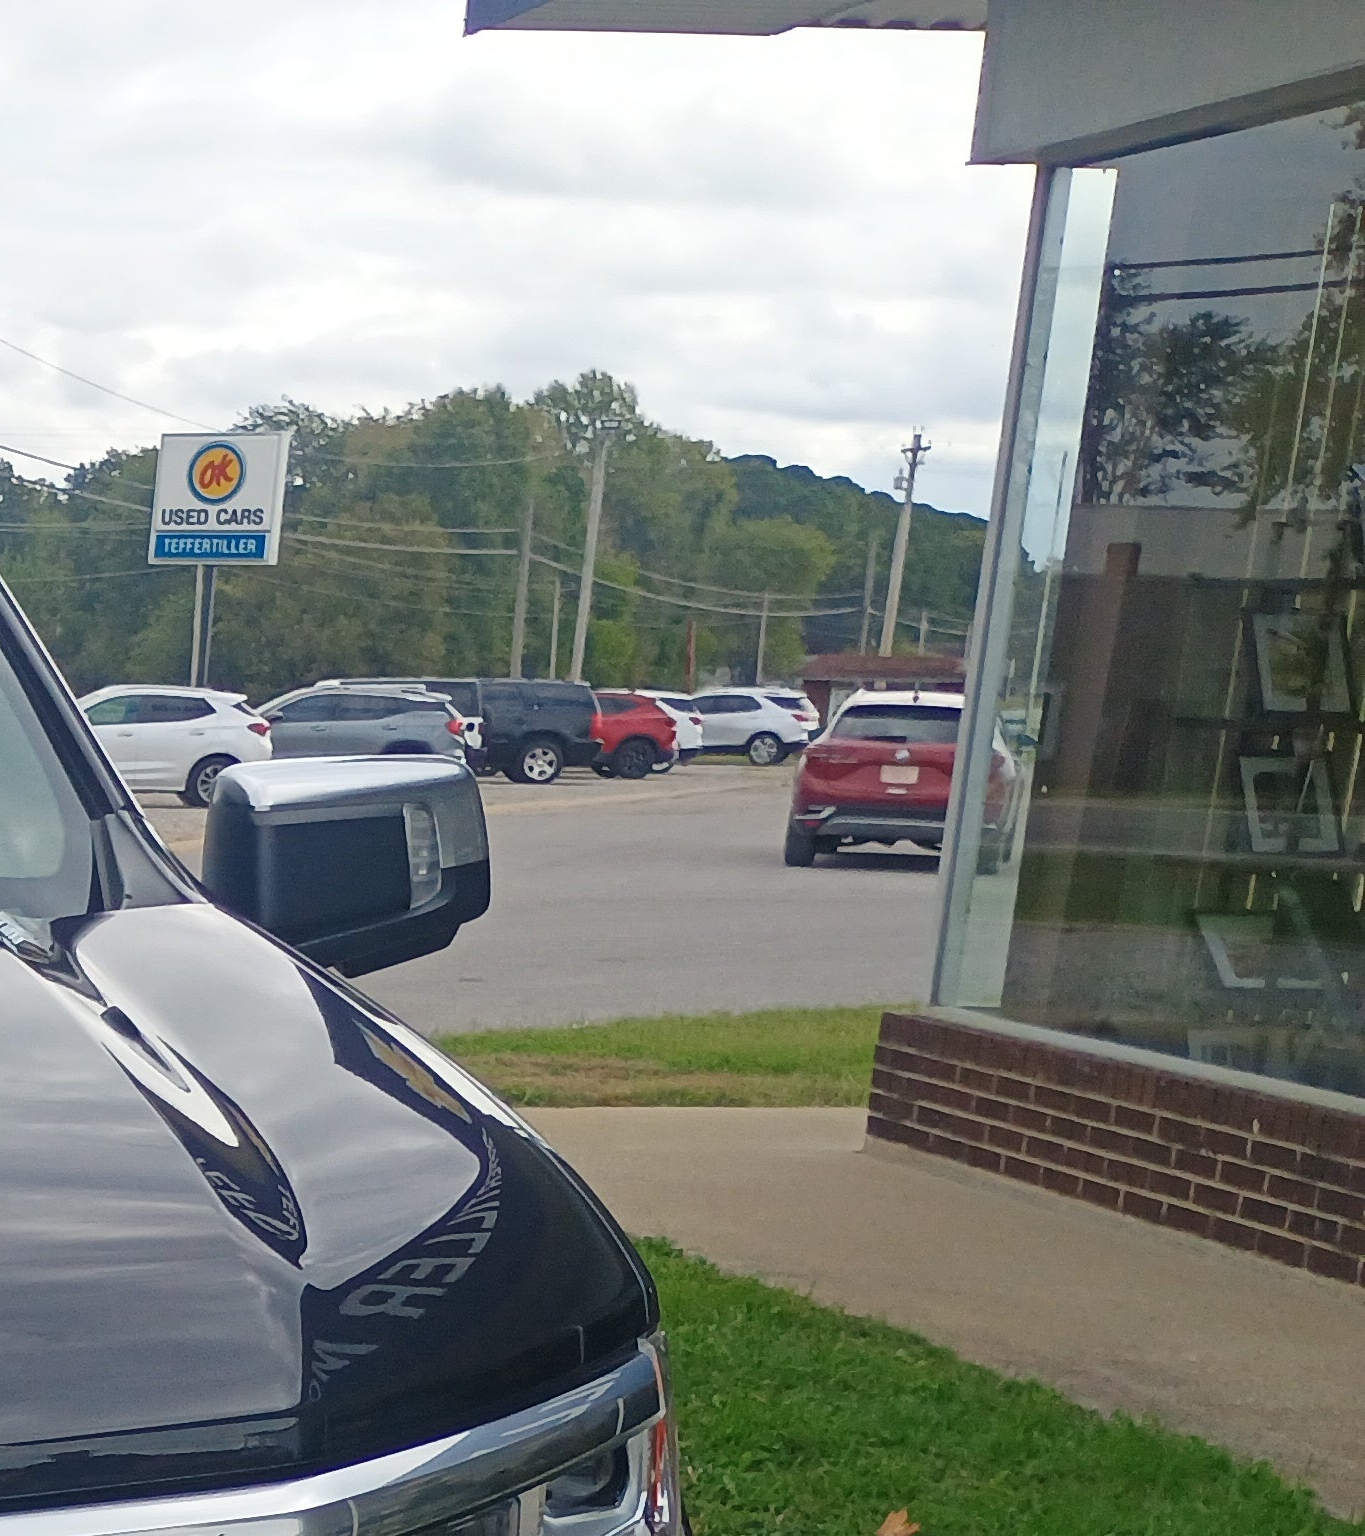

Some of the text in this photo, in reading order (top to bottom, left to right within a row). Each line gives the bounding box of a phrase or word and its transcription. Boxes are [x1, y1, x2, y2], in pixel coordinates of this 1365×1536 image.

[198, 453, 234, 490] OK
[161, 508, 265, 526] USED CARS
[164, 537, 257, 554] TEFFERTILLER
